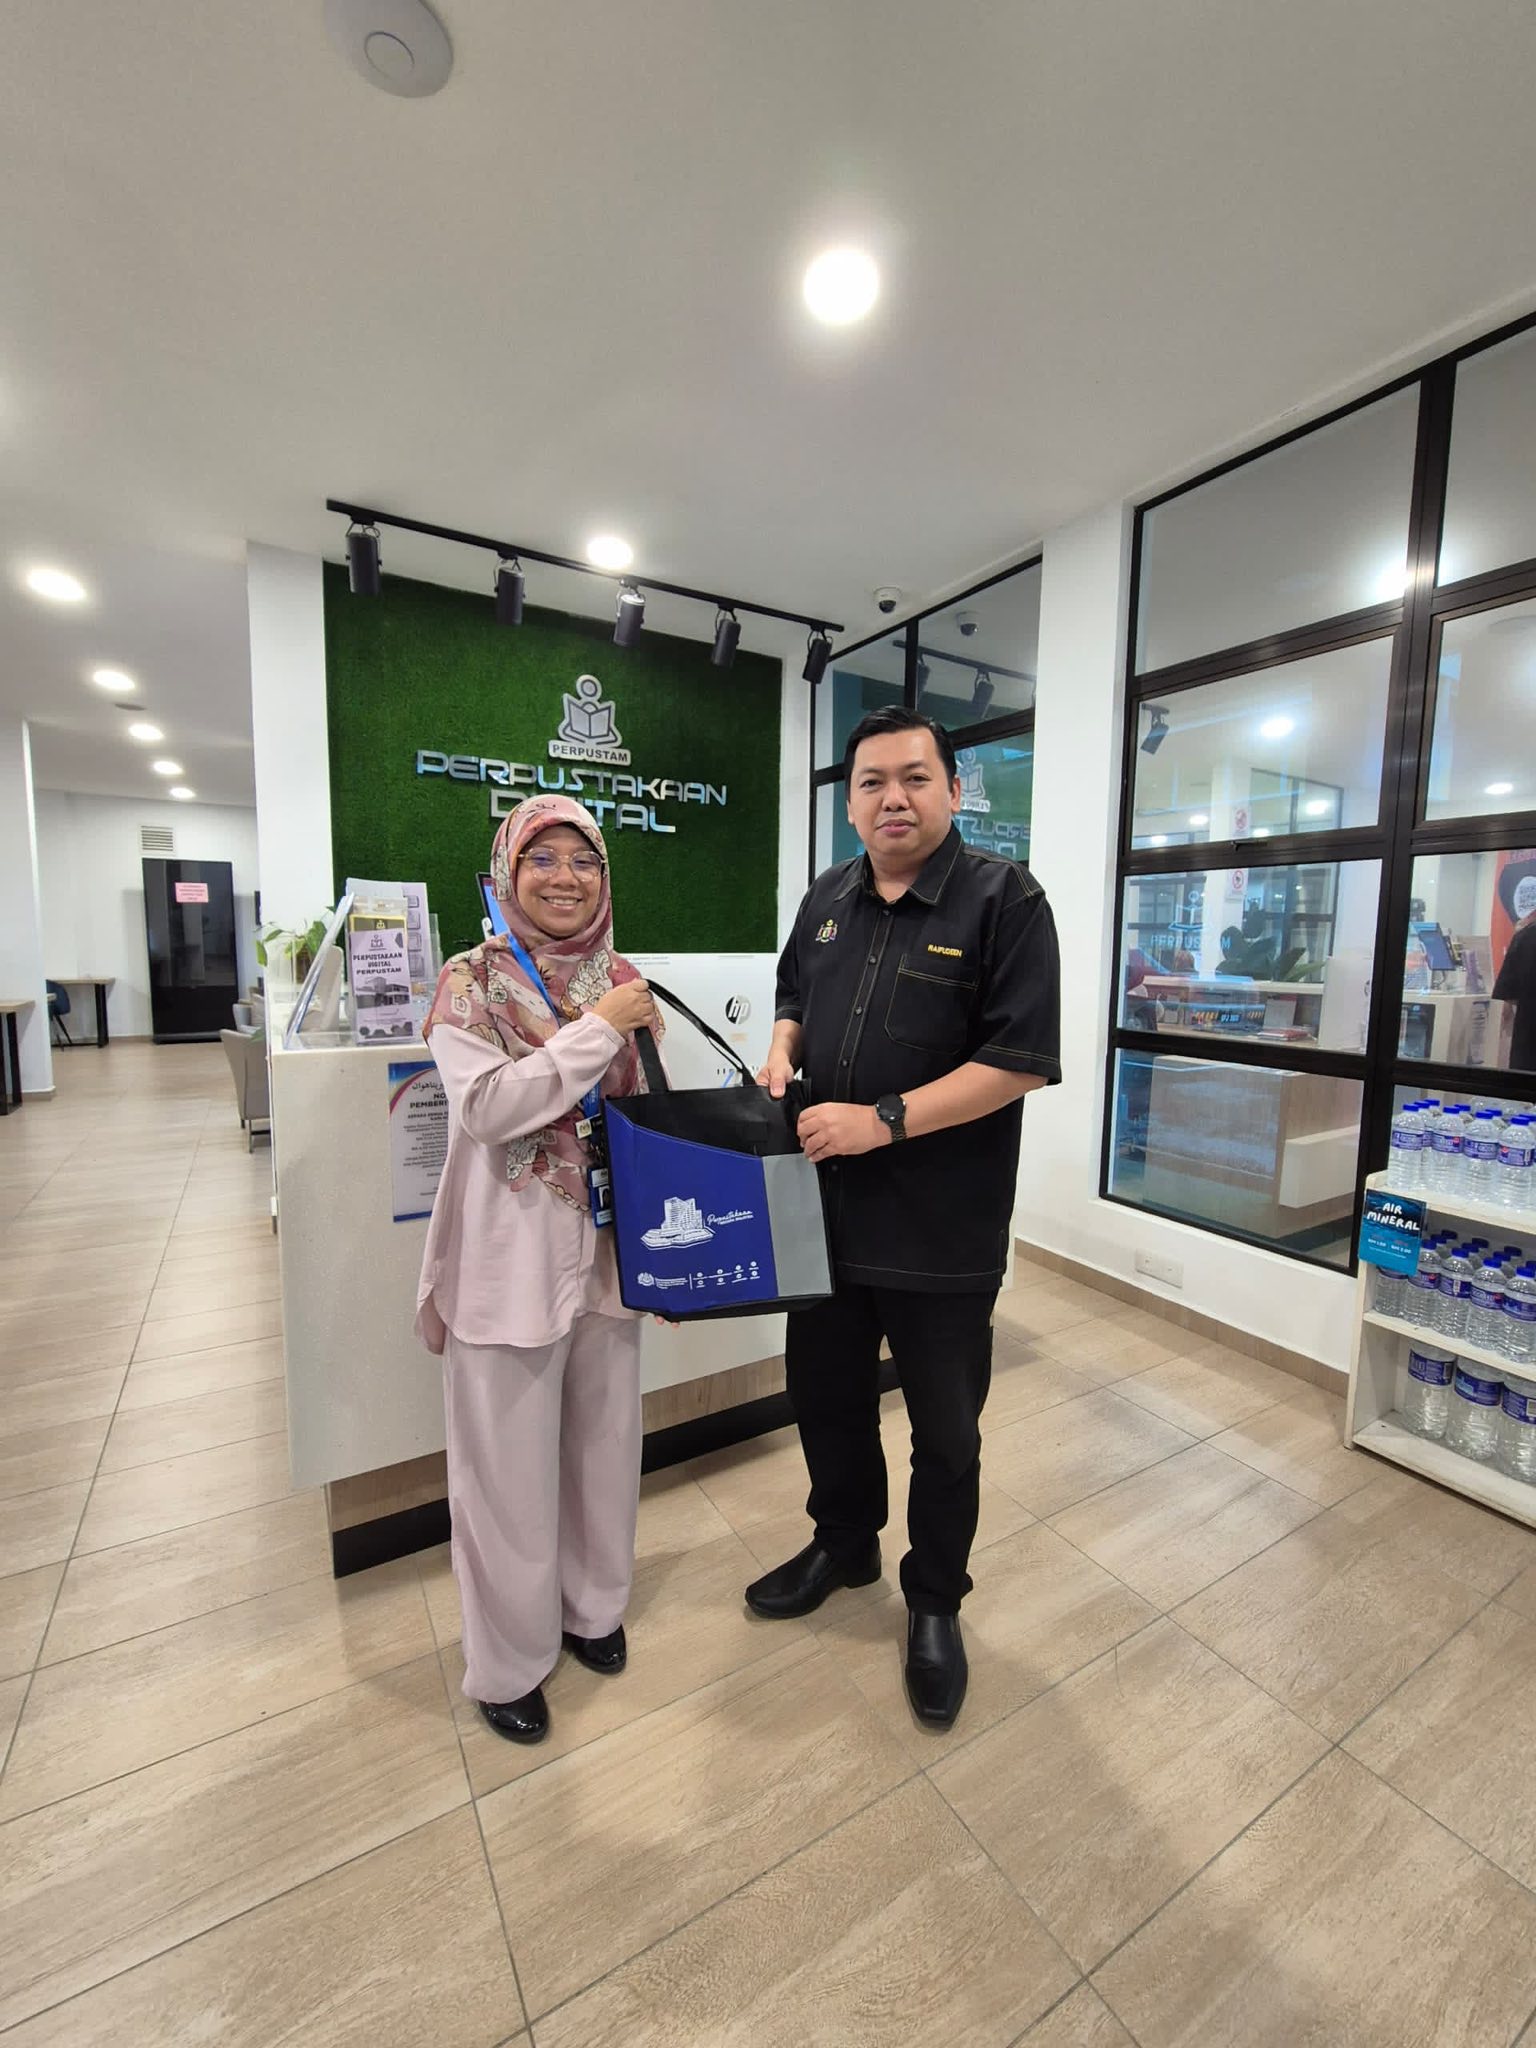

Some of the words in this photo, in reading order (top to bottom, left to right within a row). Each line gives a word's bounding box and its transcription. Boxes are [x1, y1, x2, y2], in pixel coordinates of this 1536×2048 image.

[552, 744, 628, 763] PERPUSTAM
[416, 750, 728, 806] PERPUSTAKAAN
[490, 789, 676, 833] DTAL
[353, 952, 402, 961] PERPUSTAKAAN
[725, 995, 751, 1024] hp
[410, 1100, 448, 1109] PEMBERI
[1383, 1203, 1402, 1214] AIR
[1367, 1211, 1420, 1231] MINERAL
